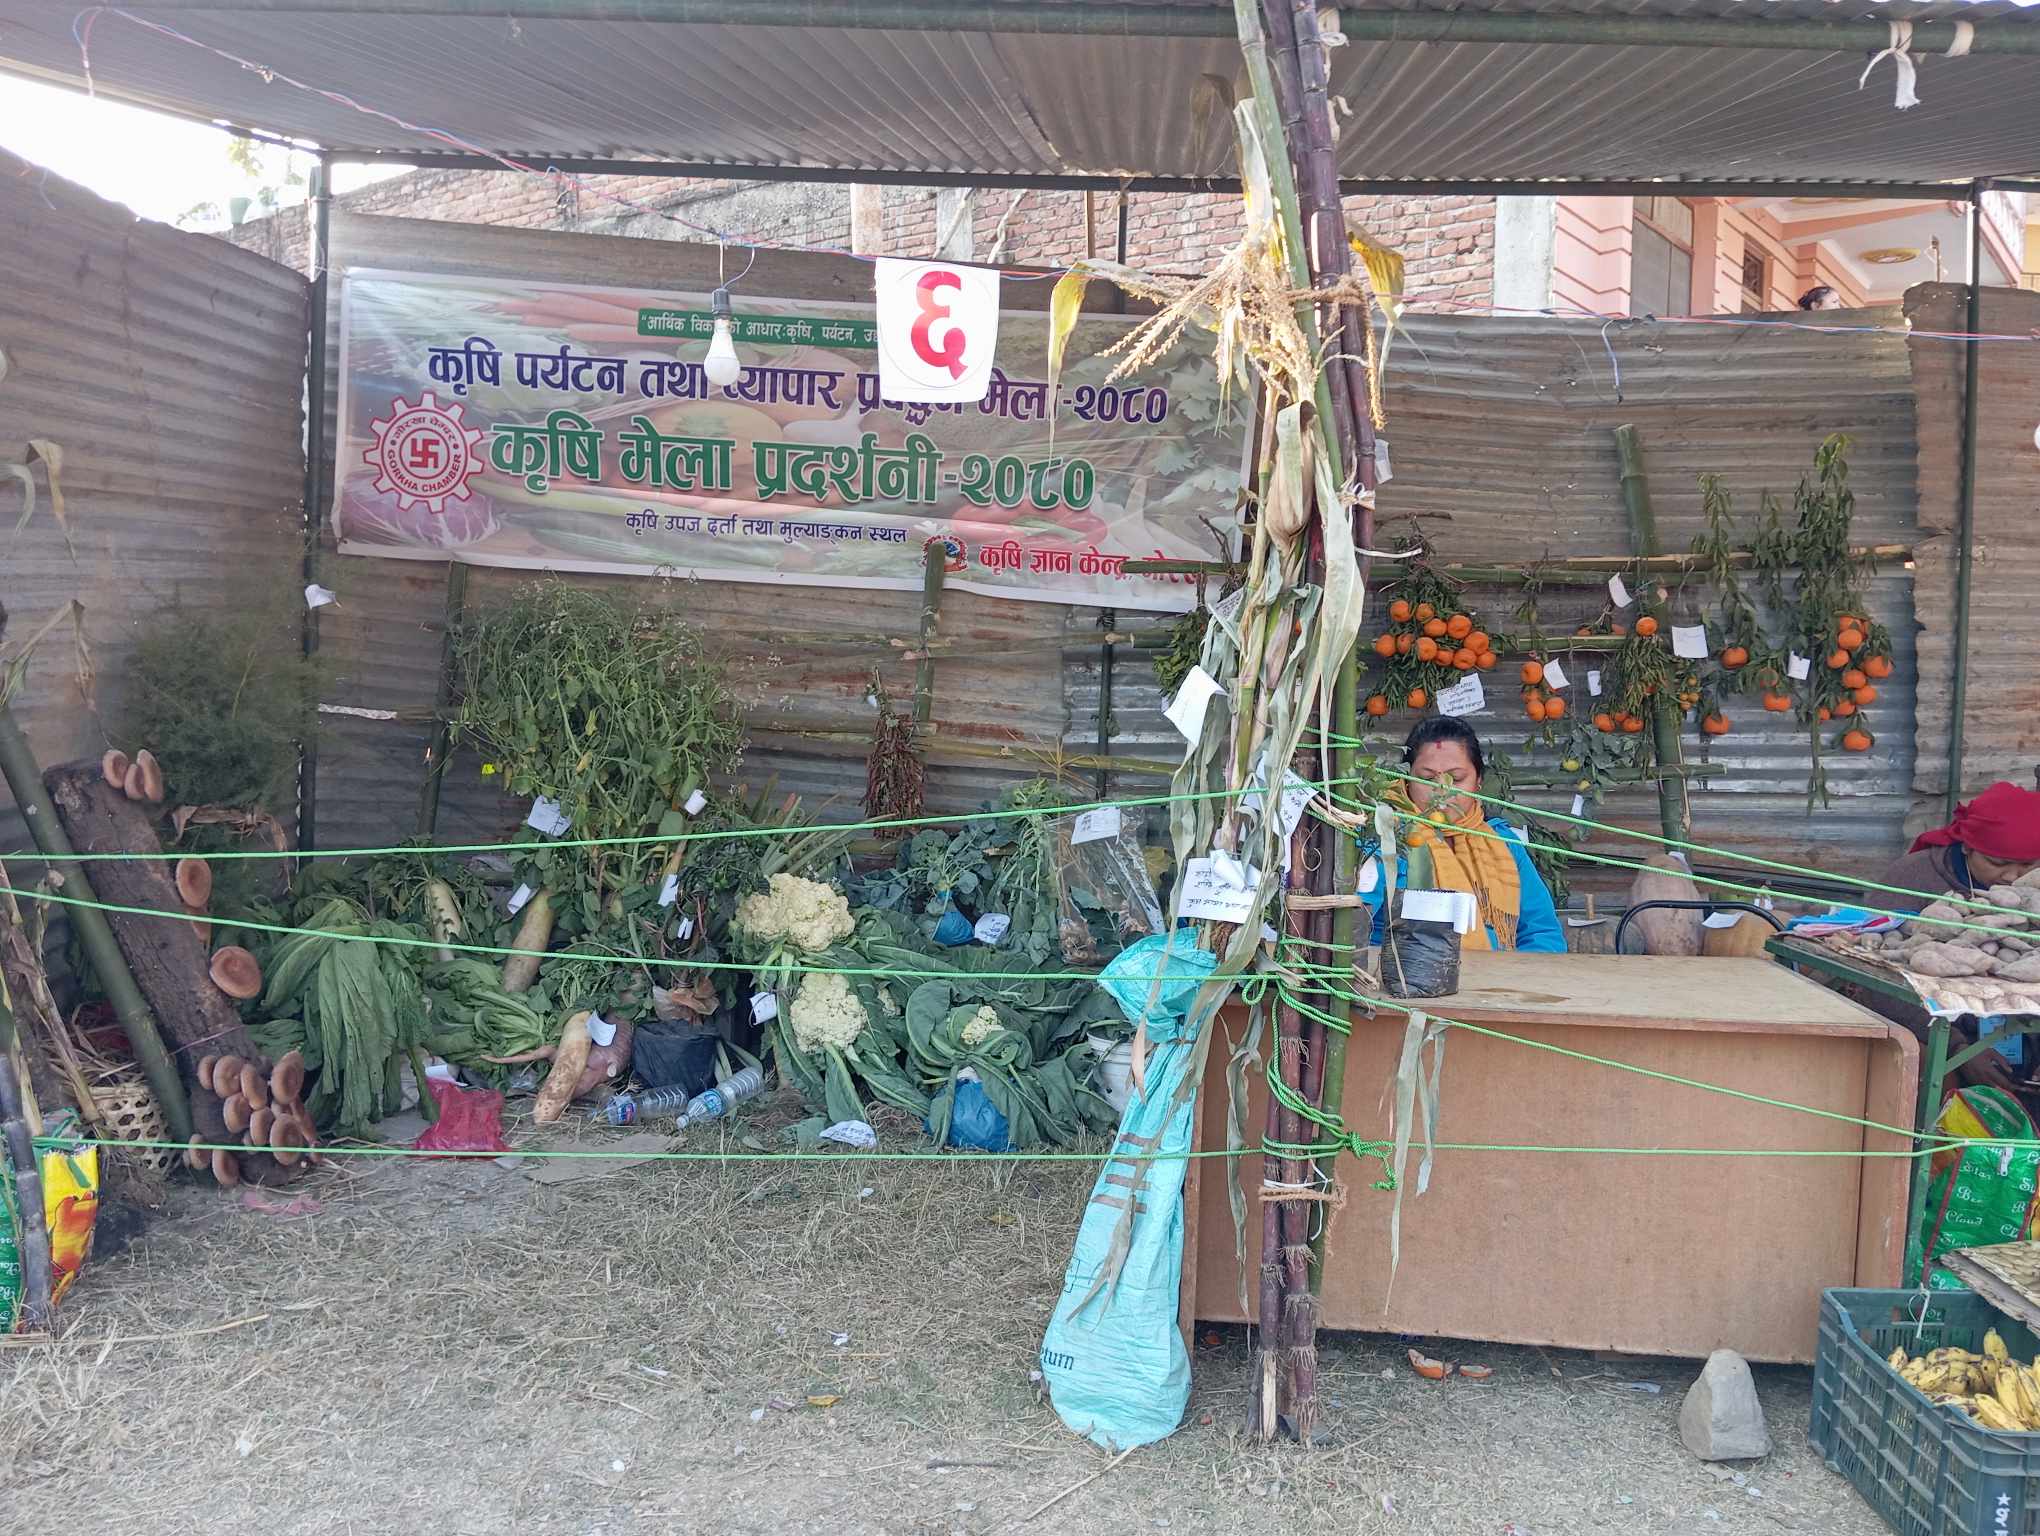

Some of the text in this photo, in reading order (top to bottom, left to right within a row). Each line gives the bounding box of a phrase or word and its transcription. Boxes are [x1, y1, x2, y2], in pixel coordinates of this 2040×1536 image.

[911, 271, 968, 380] ६
[428, 336, 502, 396] कृषि
[514, 345, 628, 395] पर्यटन
[639, 360, 708, 400] तथा
[387, 449, 461, 492] GORKHA CHAMBER
[491, 410, 603, 494] कृषि
[618, 416, 736, 490] मेला
[625, 508, 658, 536] कृषि
[664, 514, 701, 533] उपज
[707, 514, 738, 537] दर्ता
[742, 519, 774, 537] तथा
[868, 526, 908, 543] स्थल
[980, 540, 1023, 577] कृषि
[1030, 549, 1073, 575] ज्ञान
